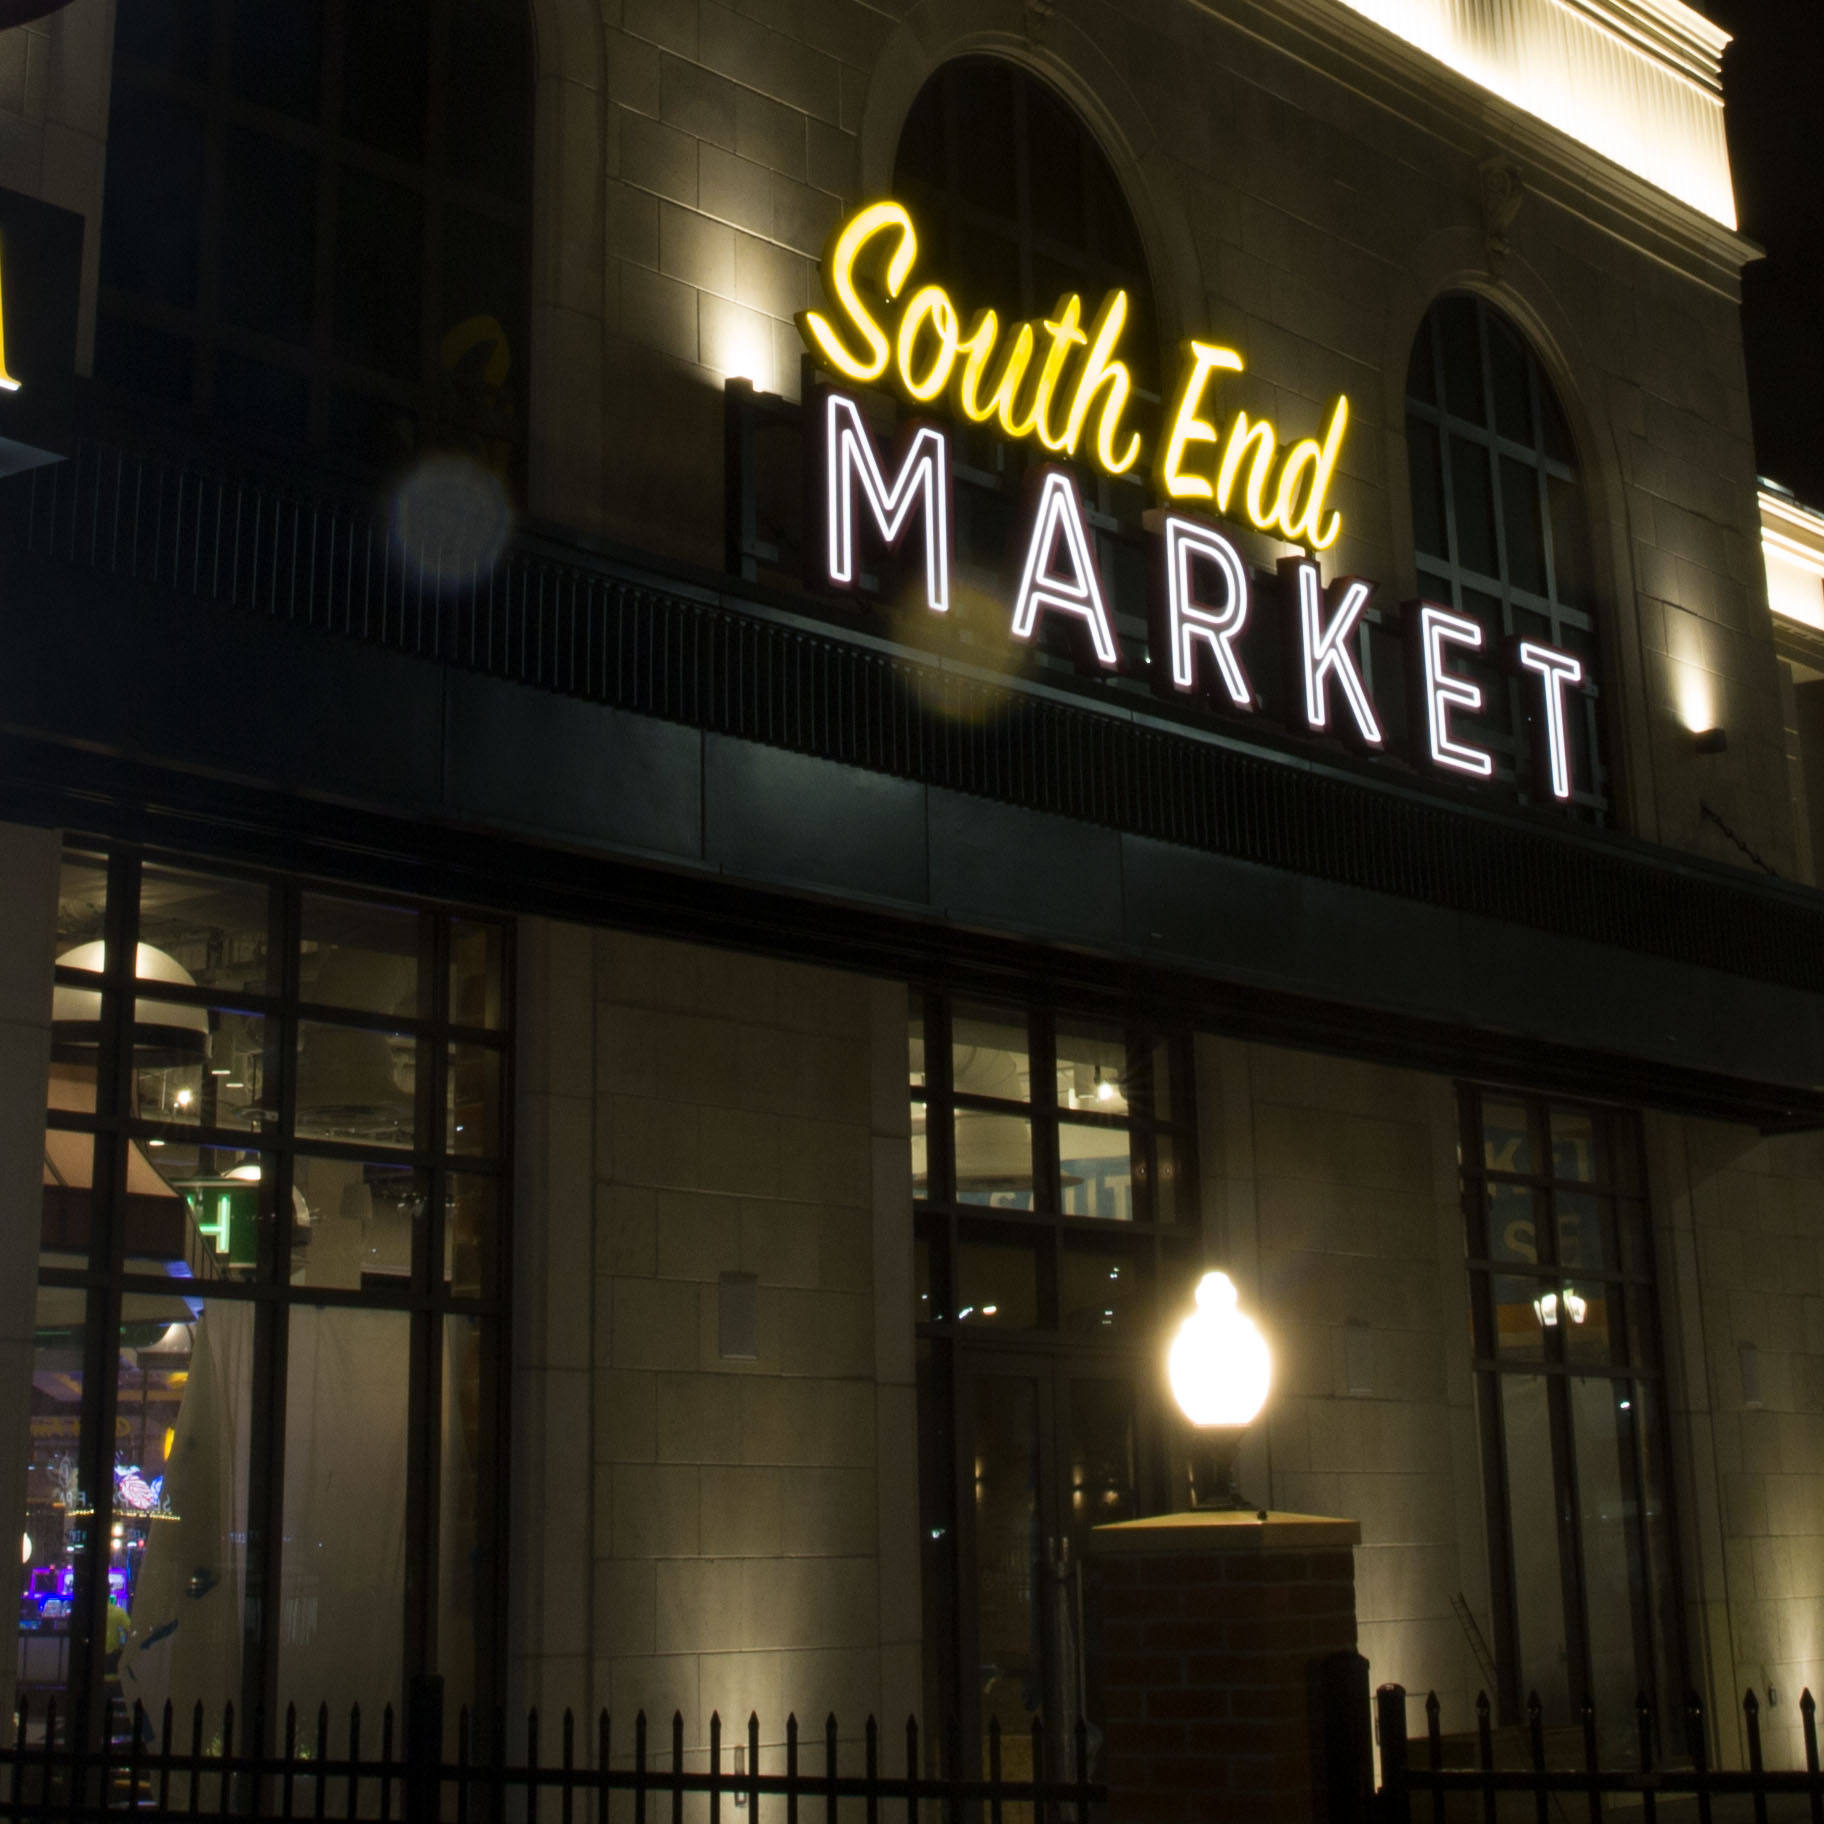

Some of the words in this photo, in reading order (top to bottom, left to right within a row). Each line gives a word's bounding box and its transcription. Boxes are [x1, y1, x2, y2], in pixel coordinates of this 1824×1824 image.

[802, 199, 1142, 476] South
[1162, 339, 1350, 553] End
[824, 392, 1582, 801] MARKET
